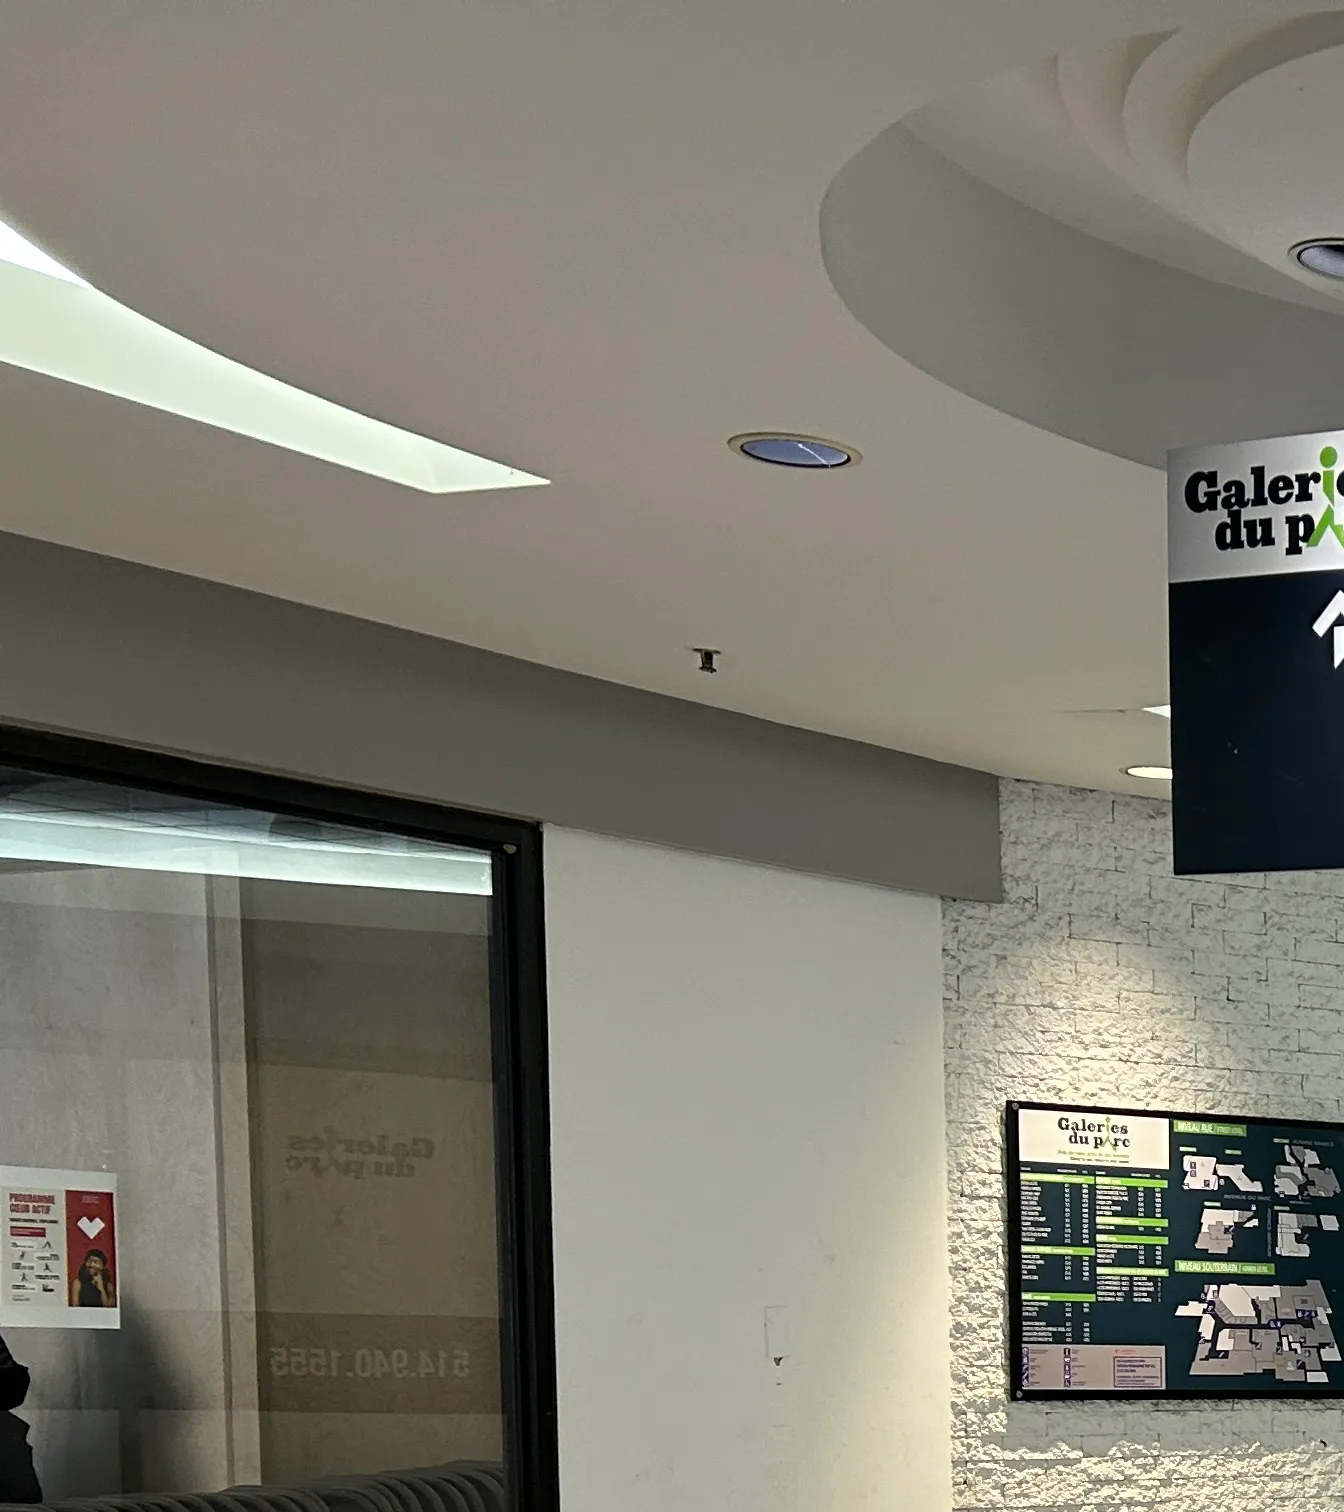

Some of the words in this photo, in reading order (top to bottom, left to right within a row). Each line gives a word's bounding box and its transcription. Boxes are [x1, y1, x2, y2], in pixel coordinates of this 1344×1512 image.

[1215, 509, 1275, 551] du
[1057, 1117, 1129, 1135] Galeries
[1069, 1131, 1089, 1145] du
[1094, 1135, 1131, 1151] parc
